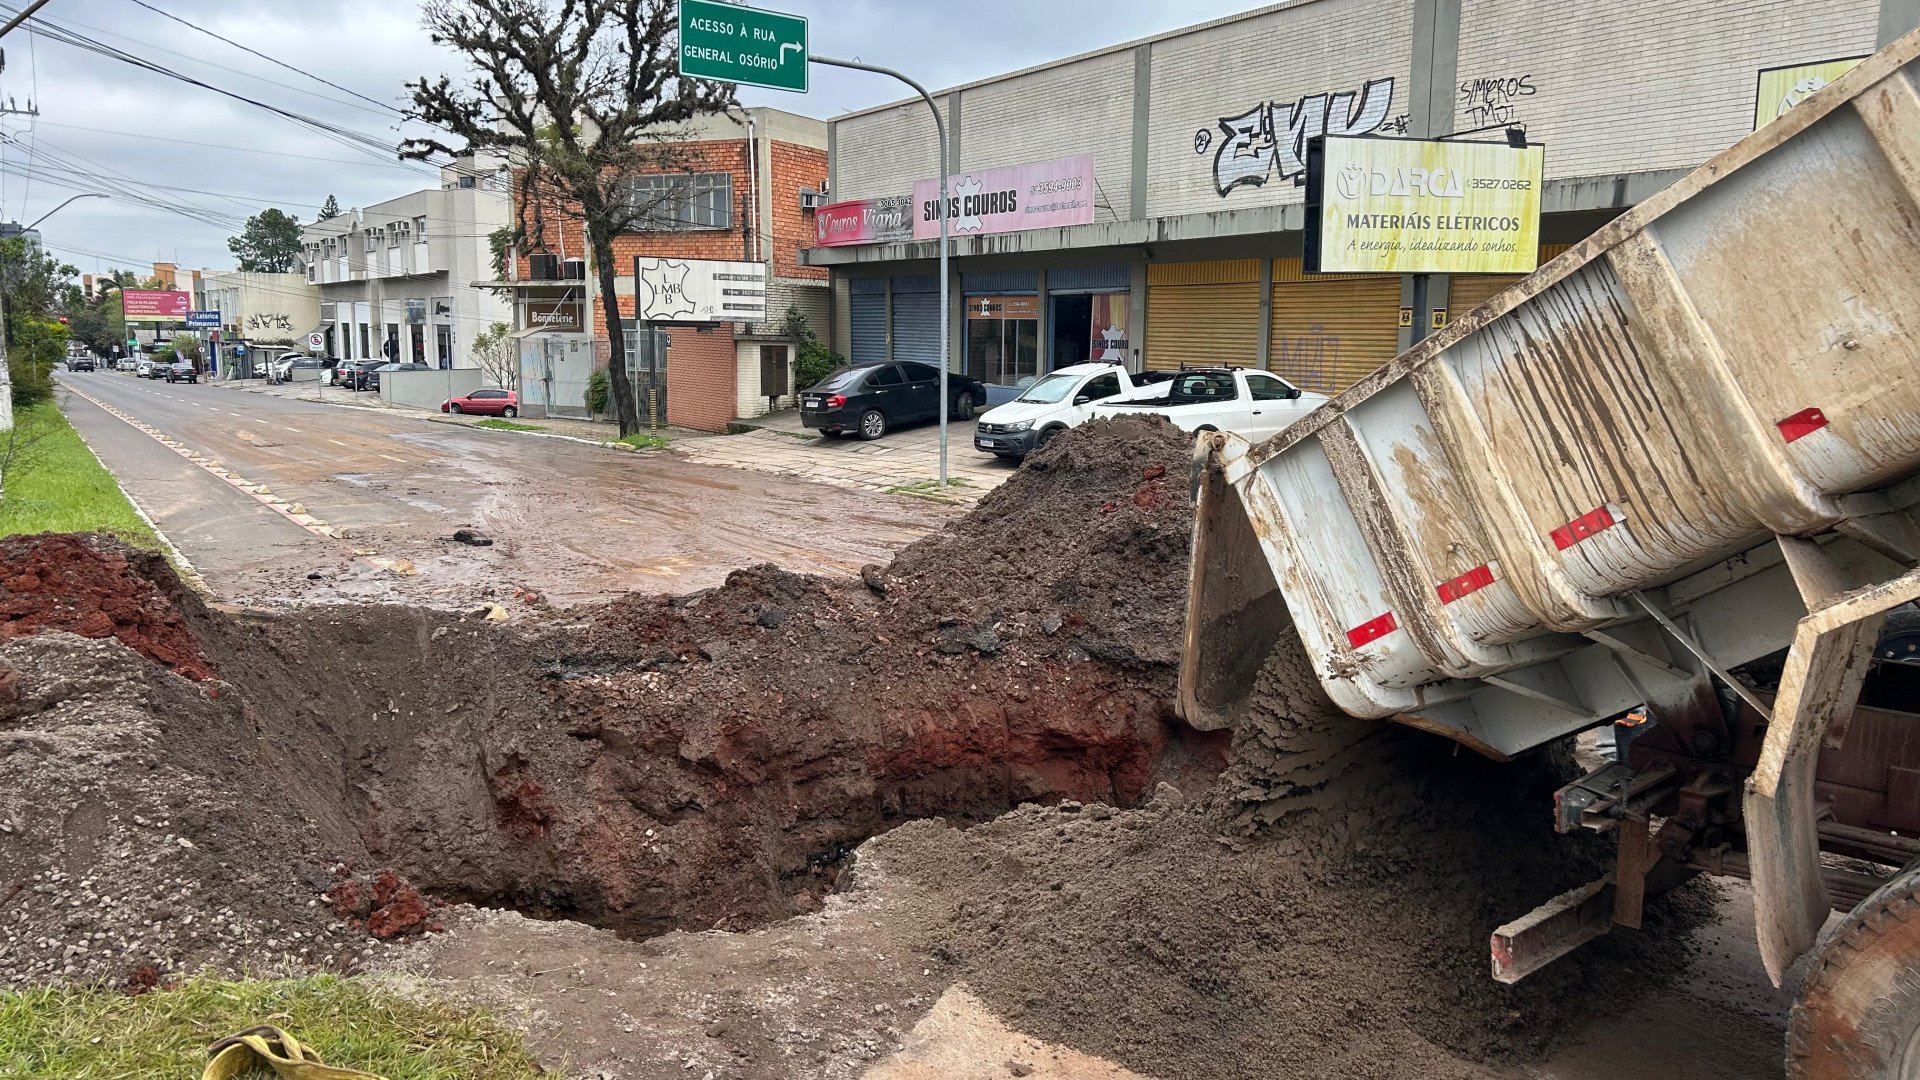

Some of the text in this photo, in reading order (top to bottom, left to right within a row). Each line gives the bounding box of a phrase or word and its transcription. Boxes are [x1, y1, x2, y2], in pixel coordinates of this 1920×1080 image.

[689, 17, 776, 42] ACESSO À RUA
[684, 45, 778, 70] GENERAL OSÓRIO
[1038, 177, 1083, 195] 3594-9003
[1369, 166, 1464, 198] DARCA
[923, 189, 1017, 221] SINOS COUROS
[825, 208, 902, 233] Couros Viana
[1347, 211, 1520, 231] MATERIÁIS ELÉTRICOS
[1346, 237, 1518, 258] A energia, idealizando sonhos.
[654, 283, 681, 294] LMB
[531, 310, 574, 323] Bonneterie
